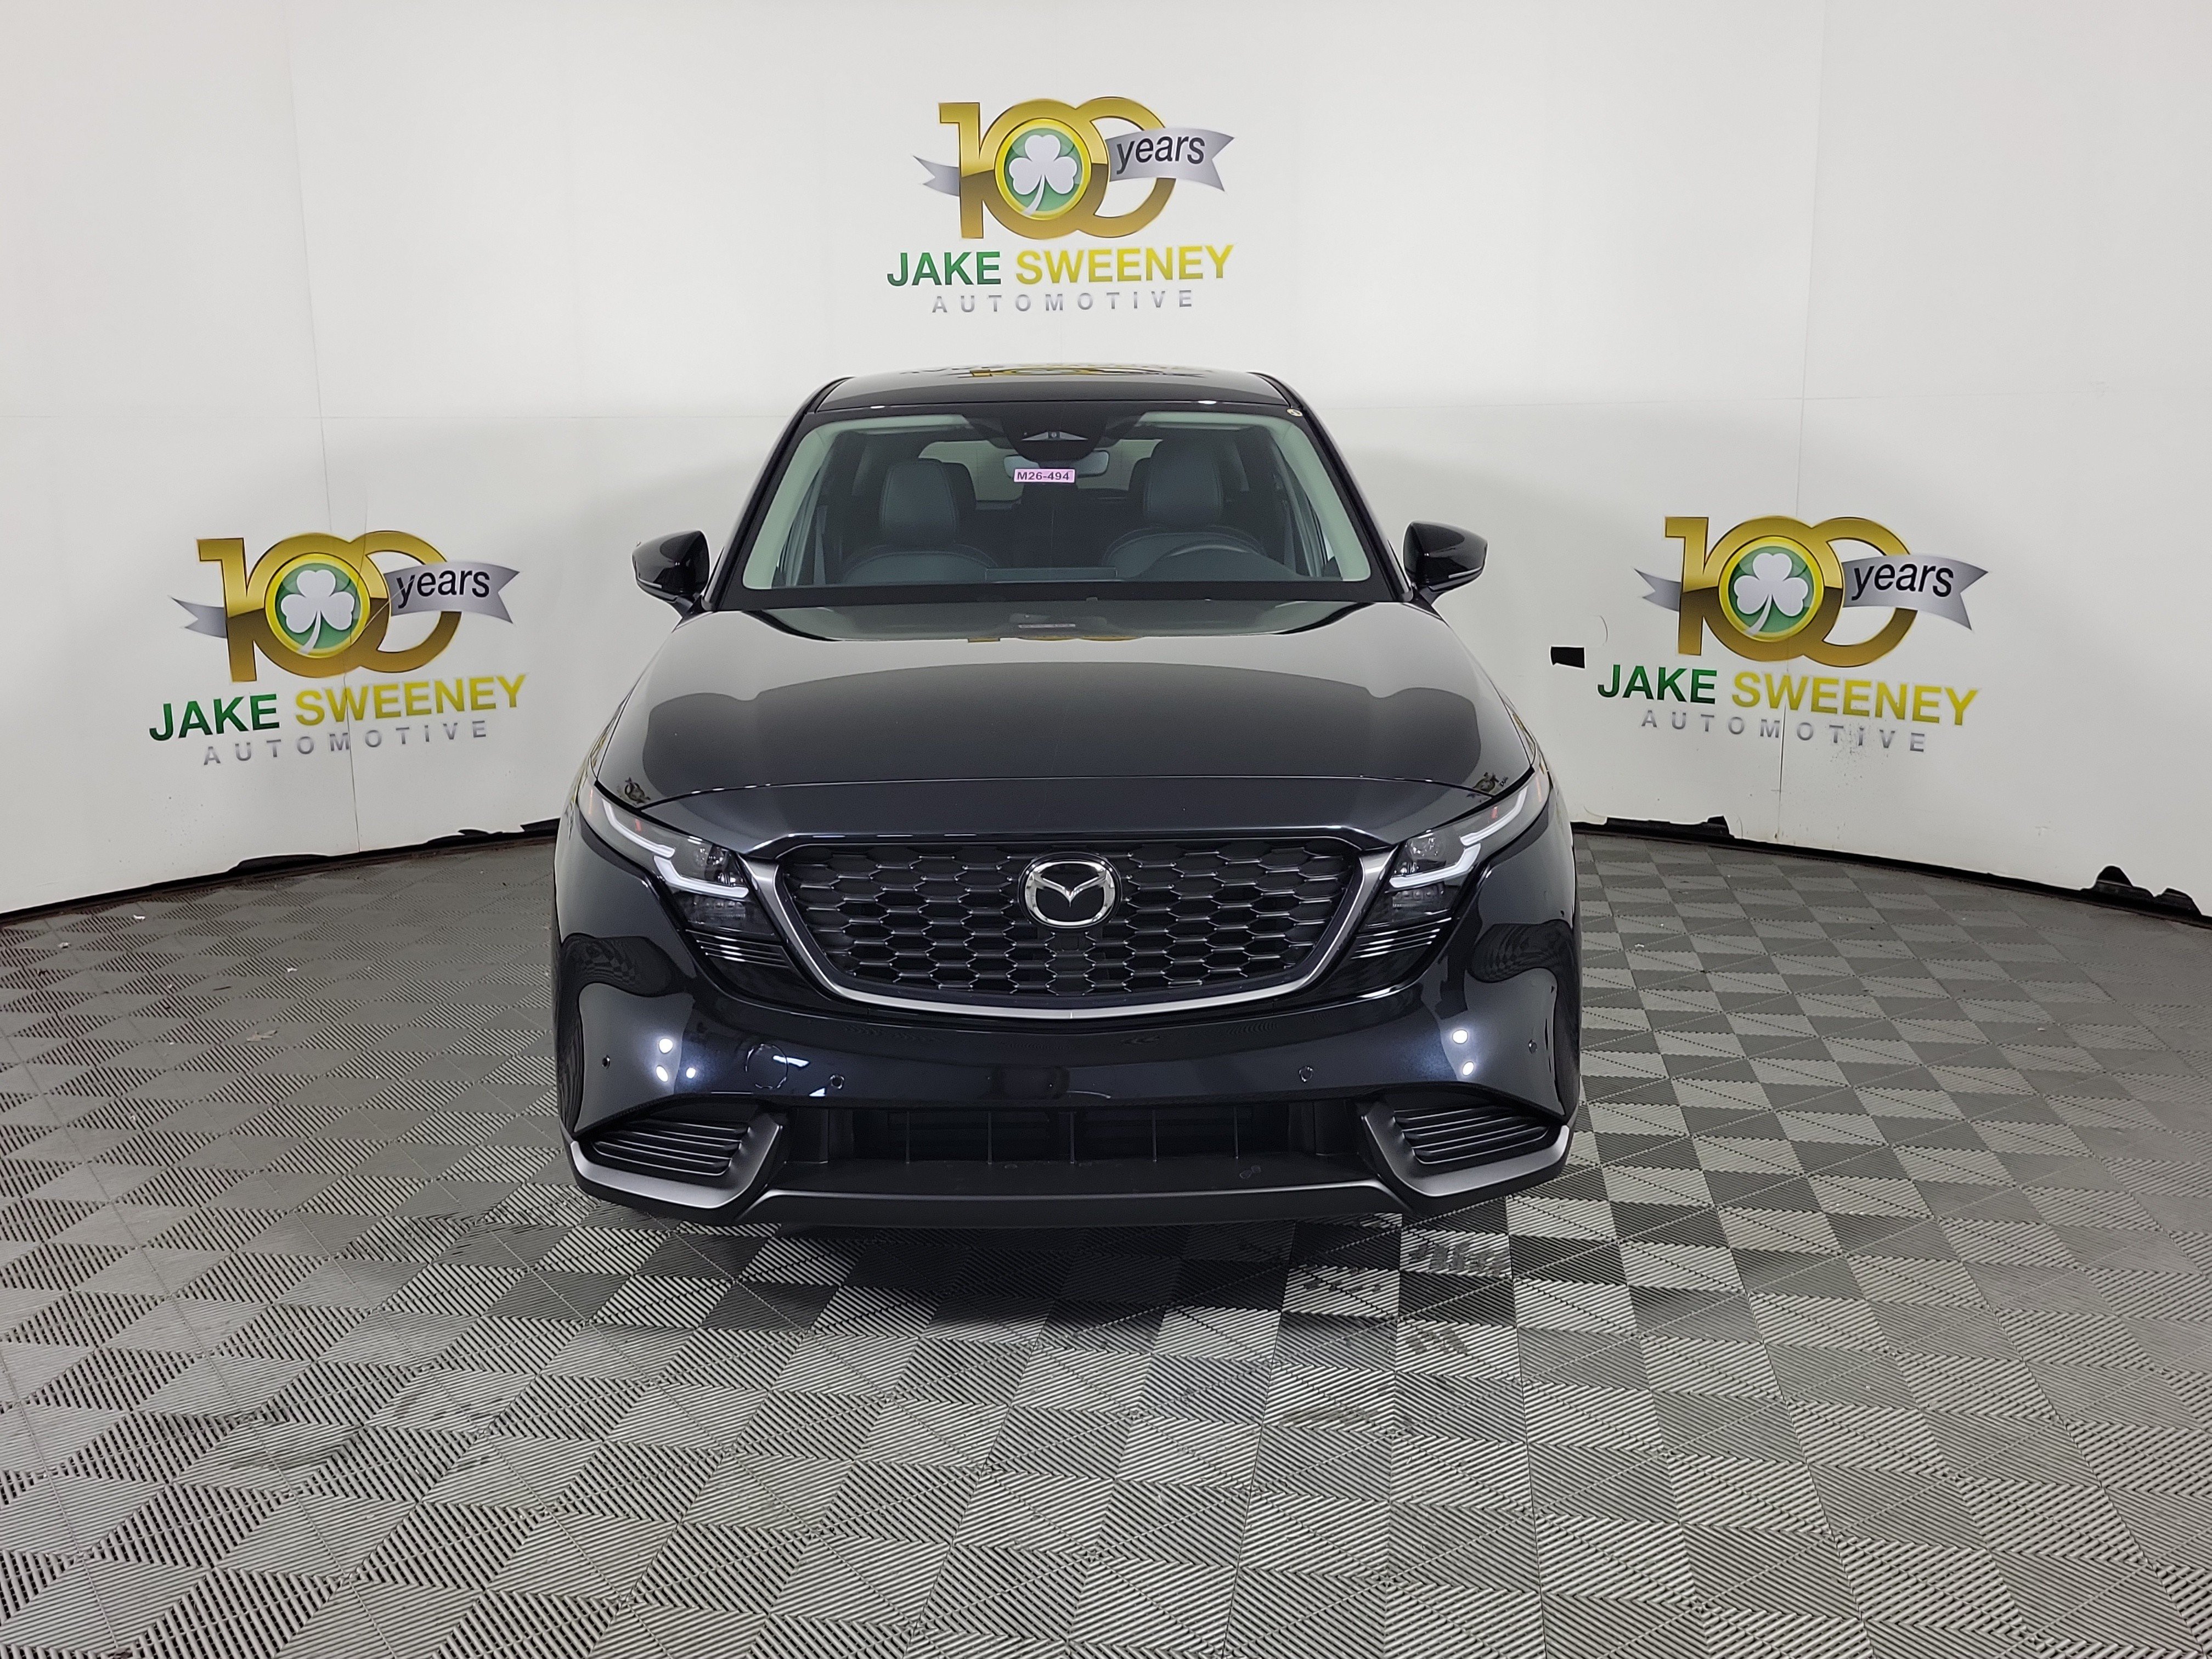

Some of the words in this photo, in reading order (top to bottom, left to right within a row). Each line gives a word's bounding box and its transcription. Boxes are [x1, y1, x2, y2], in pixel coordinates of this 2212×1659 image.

[938, 96, 1176, 240] 100
[1116, 136, 1205, 174] years
[887, 251, 1002, 287] JAKE
[1015, 245, 1234, 284] SWEENEY
[932, 290, 1192, 313] AUTOMOTIVE
[1017, 472, 1069, 480] M26-494
[196, 530, 462, 682] 100
[396, 570, 491, 608] years
[1664, 516, 1918, 667] 100
[1852, 563, 1954, 601] years
[149, 693, 280, 741] JAKE
[295, 674, 527, 726] SWEENEY
[1597, 664, 1717, 704] JAKE
[1732, 672, 1978, 726] SWEENEY
[203, 720, 487, 766] AUTOMOTIVE
[1641, 710, 1925, 752] AUTOMOTIVE
